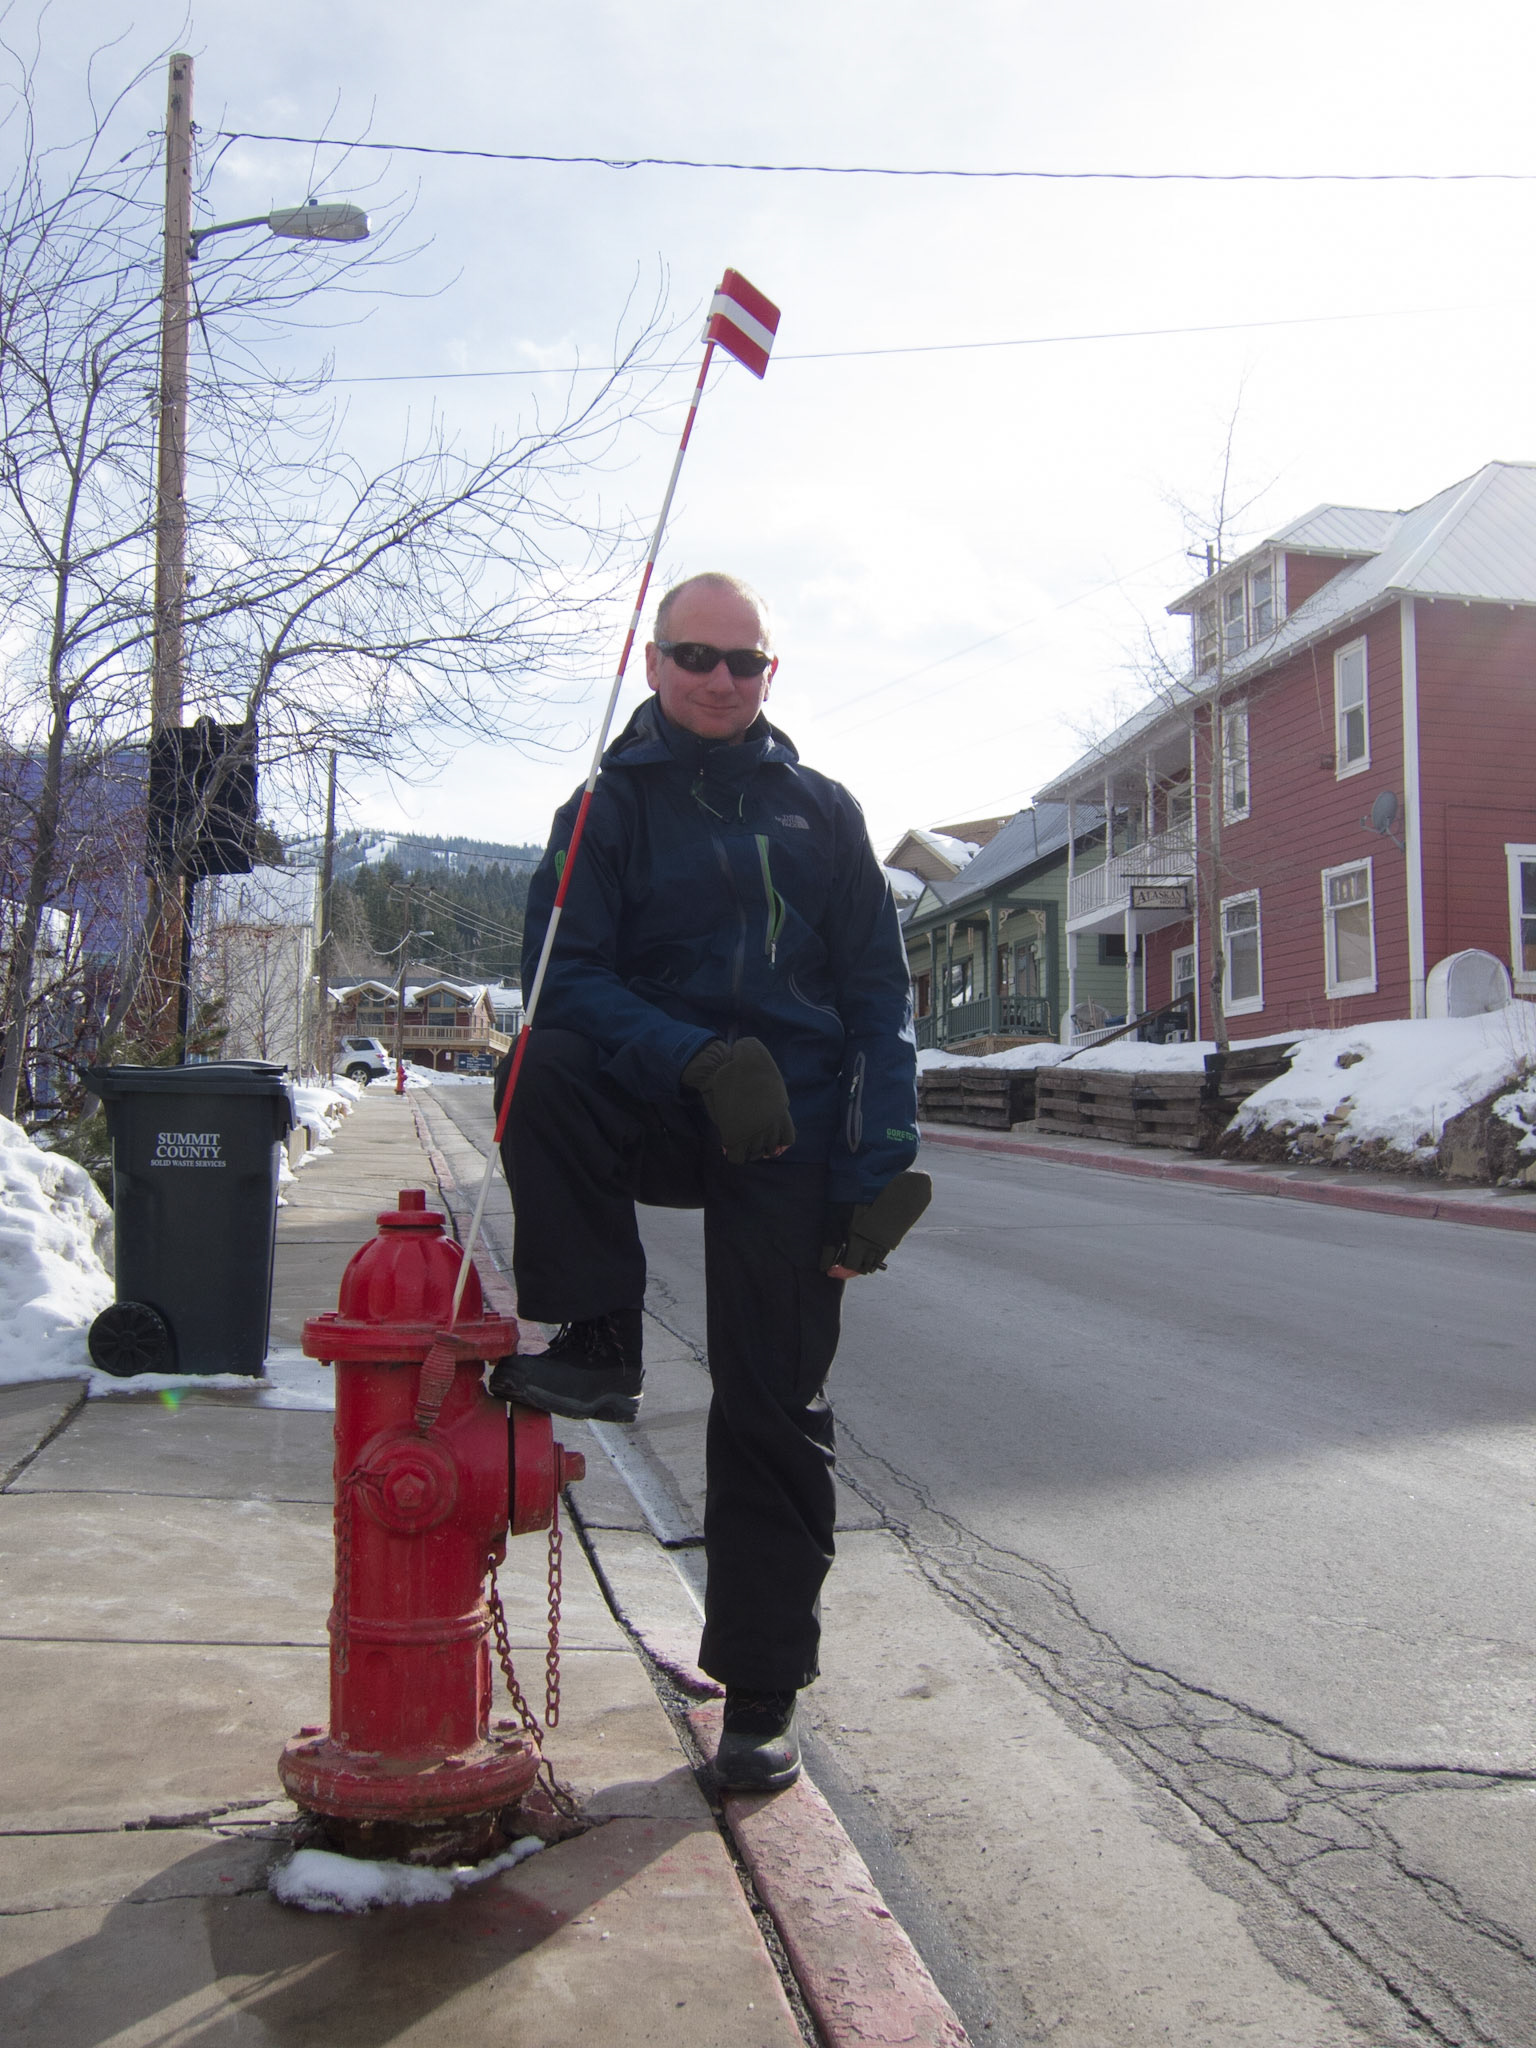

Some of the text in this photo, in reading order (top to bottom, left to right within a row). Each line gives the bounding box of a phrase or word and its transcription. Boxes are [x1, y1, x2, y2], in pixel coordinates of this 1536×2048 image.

[158, 1132, 220, 1145] SUMMIT
[156, 1145, 221, 1159] COUNTY
[150, 1159, 226, 1168] SOLID WASTE SERVICES
